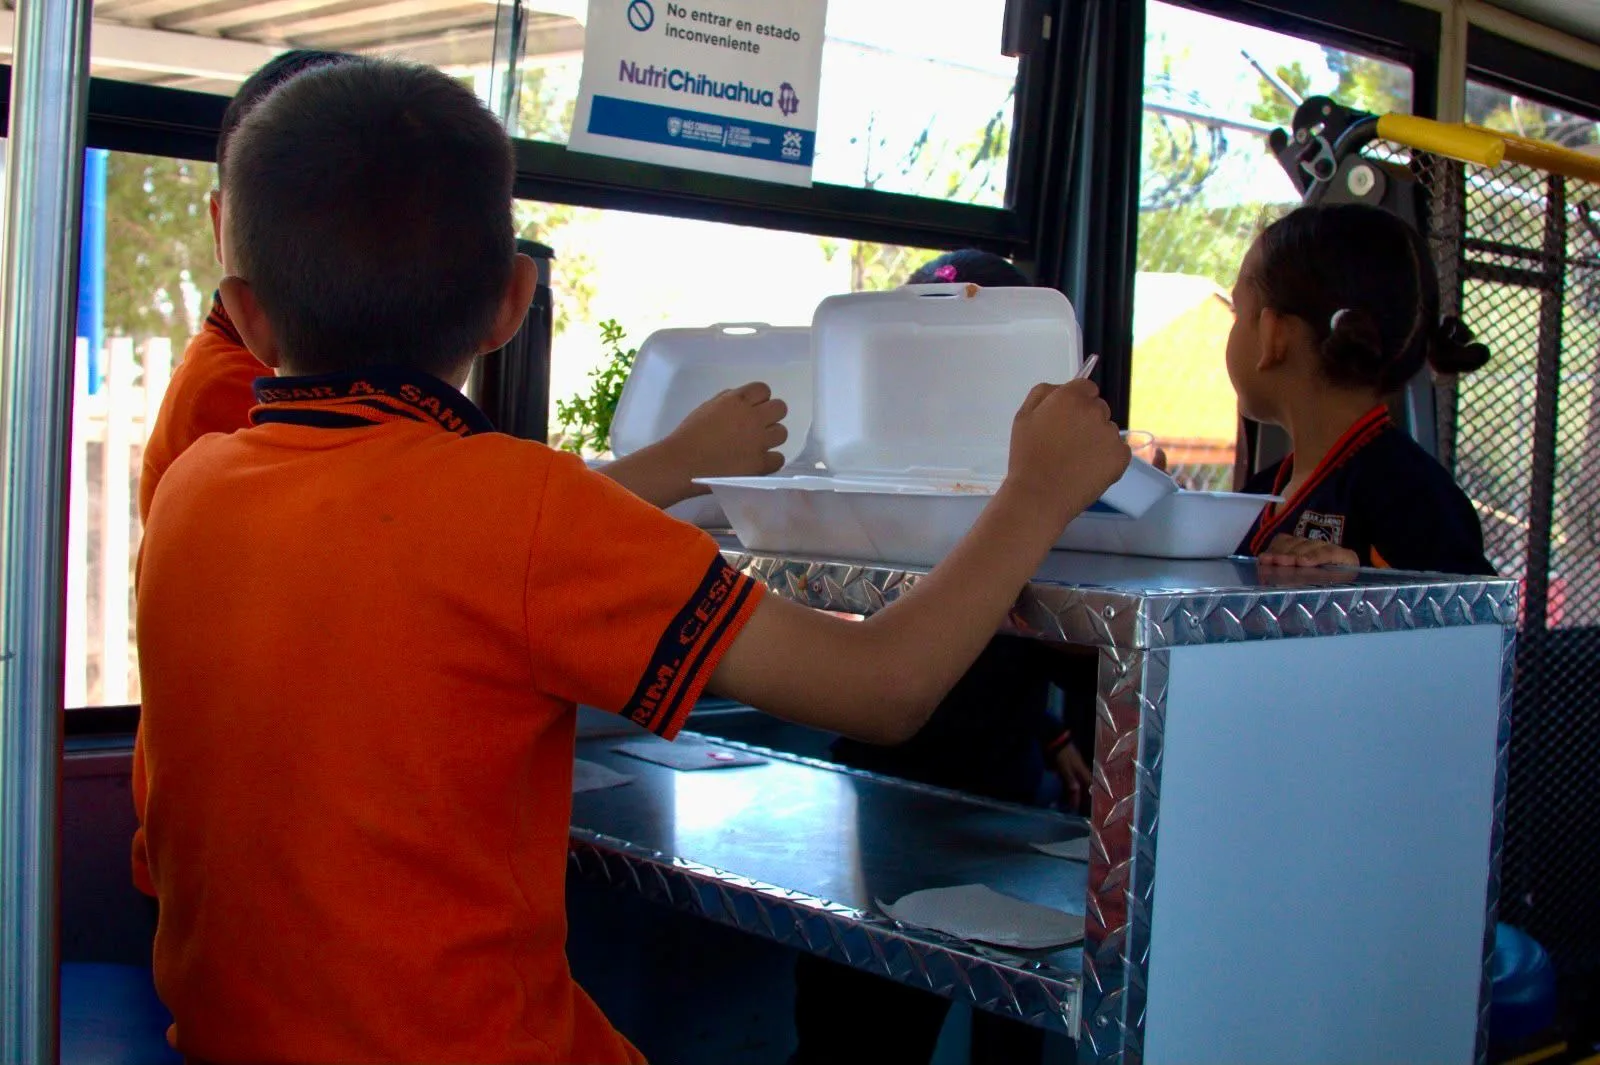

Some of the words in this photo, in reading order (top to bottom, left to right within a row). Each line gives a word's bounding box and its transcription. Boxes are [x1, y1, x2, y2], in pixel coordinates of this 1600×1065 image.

[665, 23, 761, 54] inconveniente
[667, 2, 687, 19] No
[691, 11, 733, 29] entrar
[736, 18, 752, 32] en
[756, 23, 801, 42] estado
[619, 59, 774, 108] NutriChihuahua
